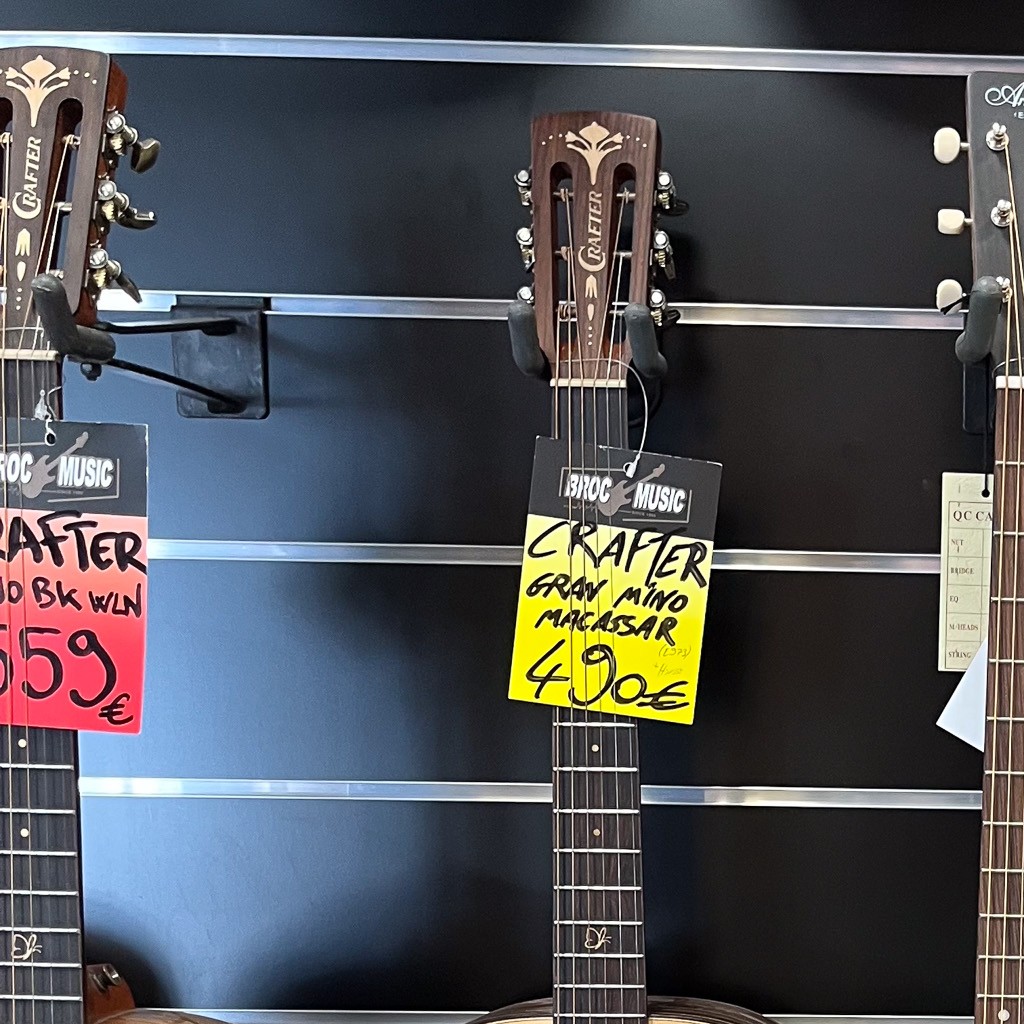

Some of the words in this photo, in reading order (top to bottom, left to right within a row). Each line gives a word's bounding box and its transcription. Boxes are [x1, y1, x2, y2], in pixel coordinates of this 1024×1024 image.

[12, 136, 42, 220] CRAFTER
[58, 455, 115, 490] MUSIC
[564, 473, 613, 504] BROC
[631, 482, 688, 514] MUSIC
[527, 520, 707, 588] CRAFTER
[534, 608, 677, 647] MACASSAR
